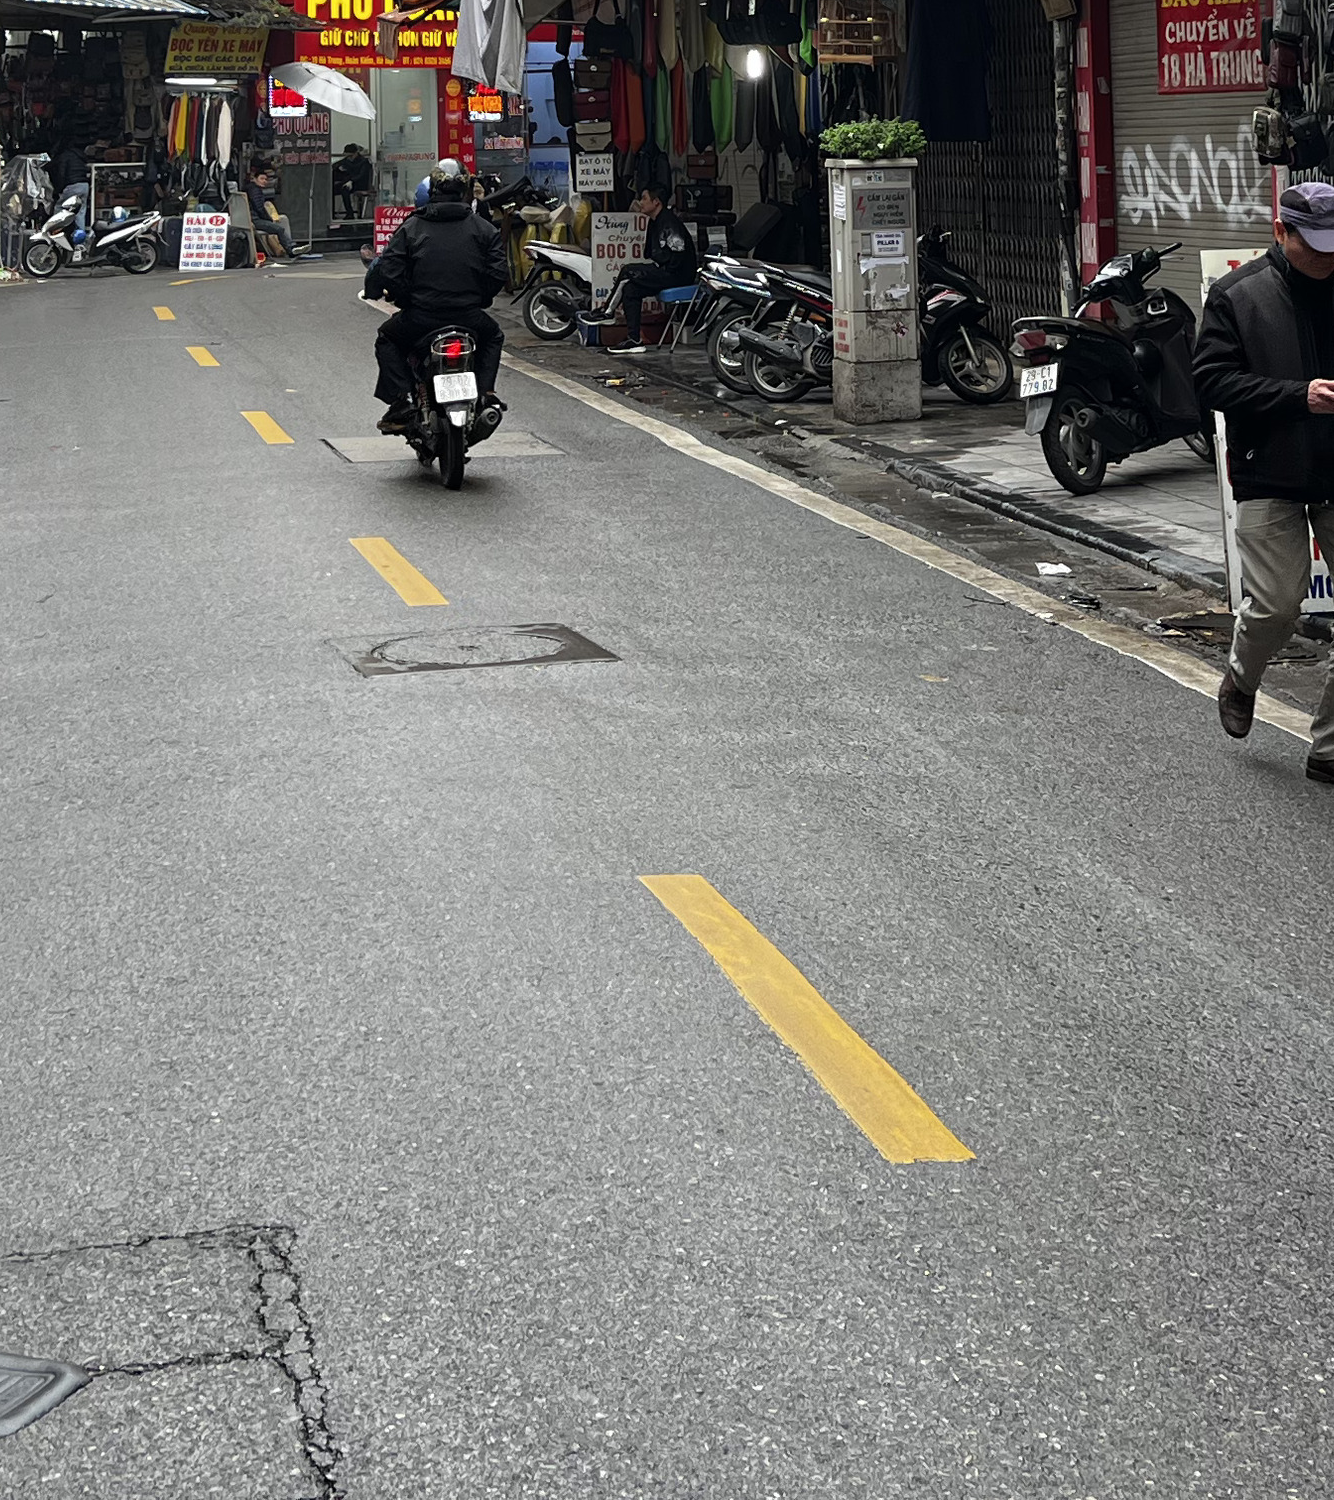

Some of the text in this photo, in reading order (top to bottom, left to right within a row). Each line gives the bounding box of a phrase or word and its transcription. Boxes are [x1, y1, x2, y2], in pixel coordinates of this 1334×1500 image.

[1165, 7, 1257, 45] CHUYỂN VỀ
[170, 36, 264, 54] BỌC YÊN XE MÁY
[320, 27, 342, 46] GIỮ
[345, 27, 370, 46] CHỮ
[422, 28, 442, 47] GIỮ
[1161, 45, 1264, 87] 18 HÀ TRUNG
[294, 112, 329, 136] QUANG
[212, 216, 223, 224] 17
[597, 243, 626, 262] BỌC
